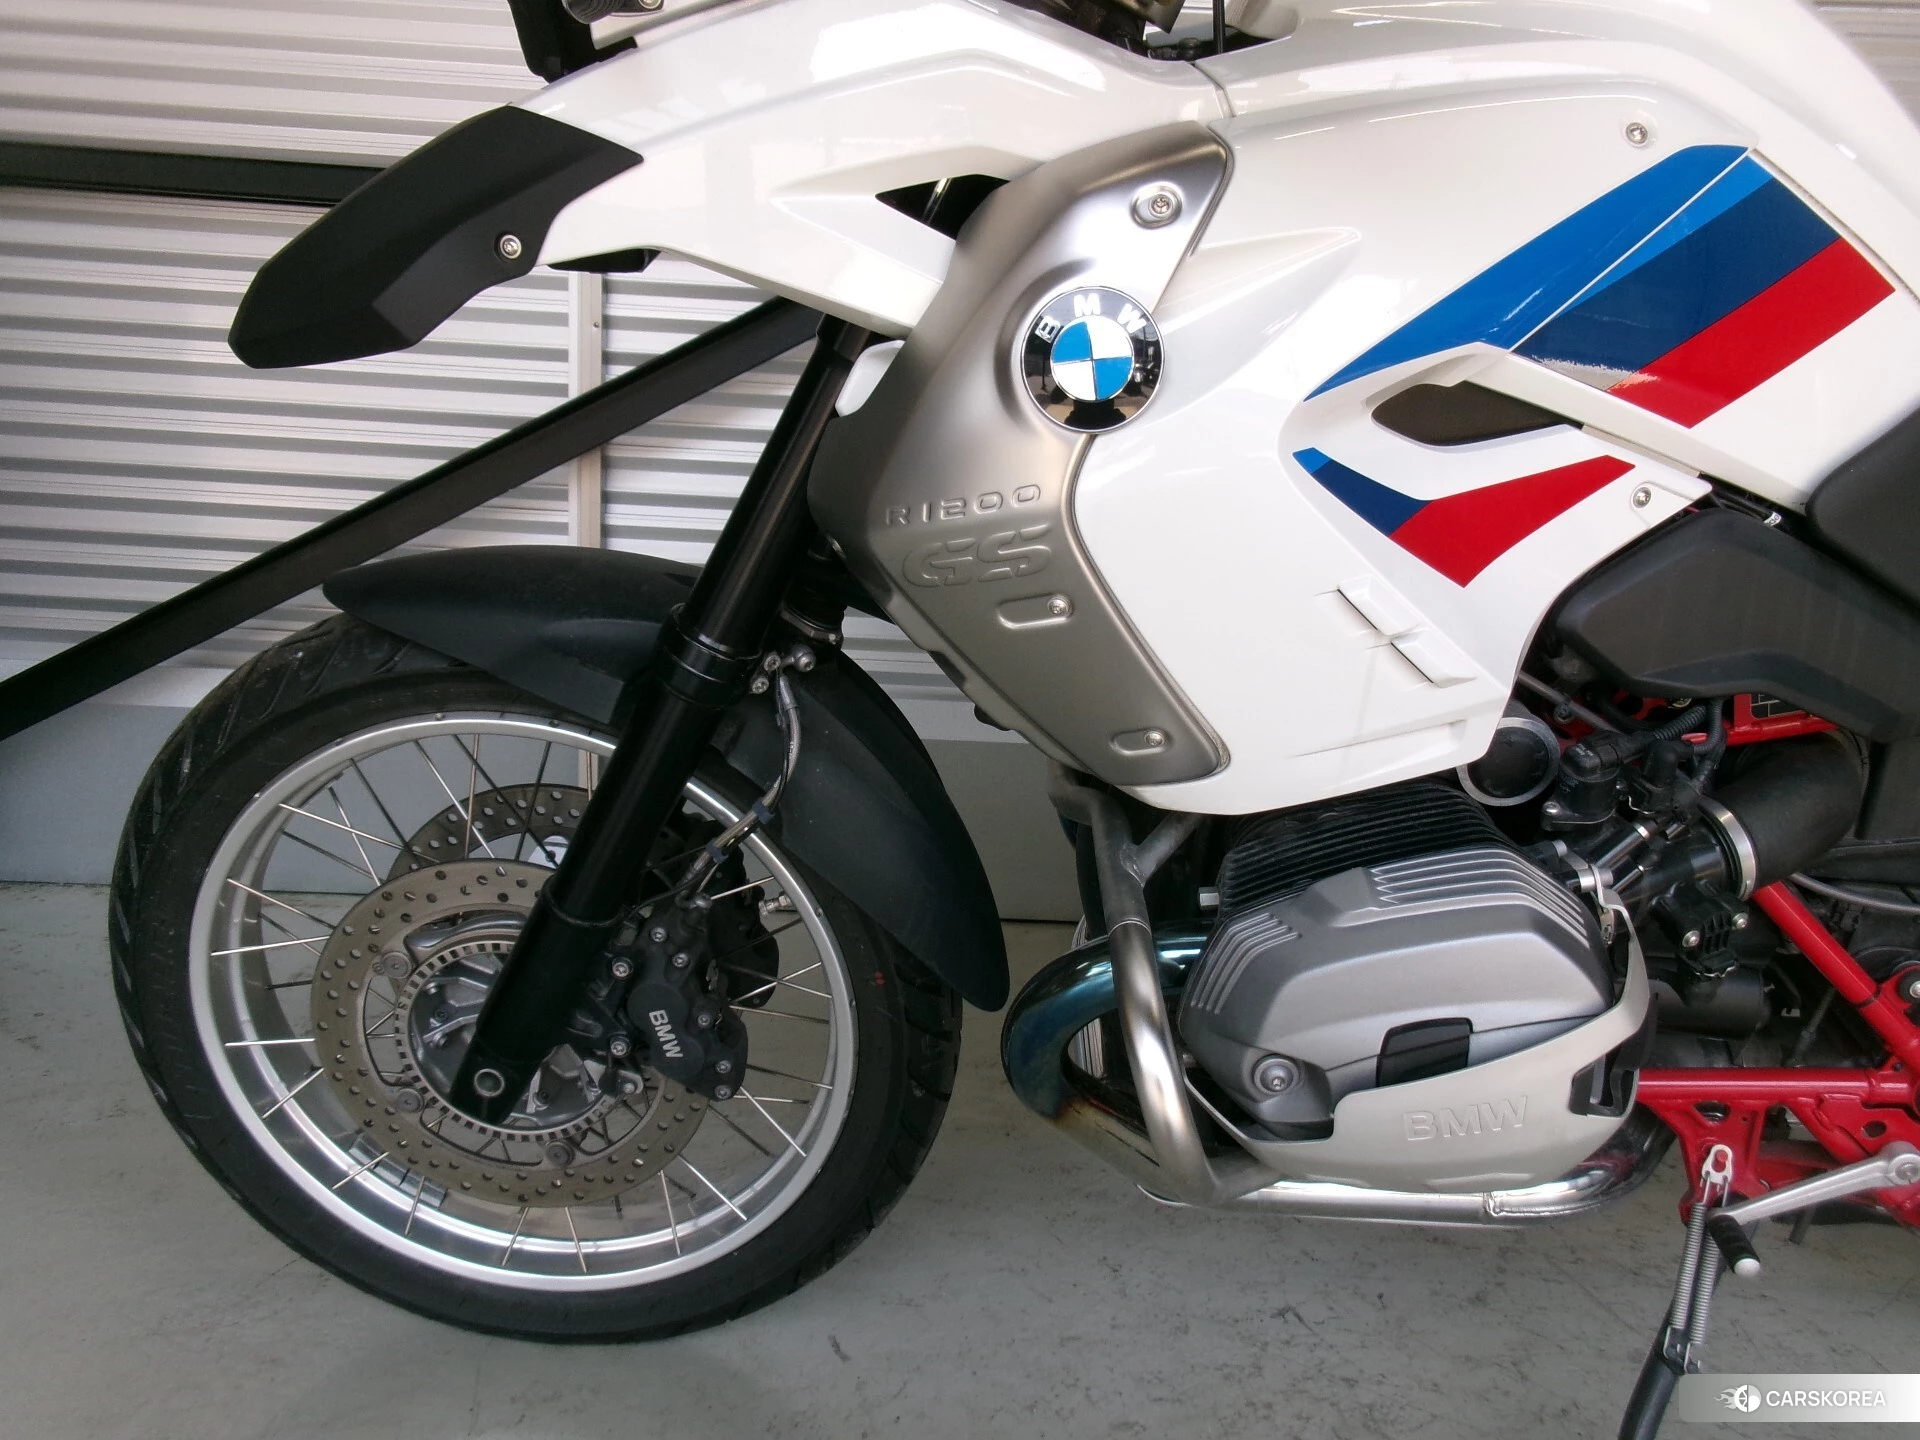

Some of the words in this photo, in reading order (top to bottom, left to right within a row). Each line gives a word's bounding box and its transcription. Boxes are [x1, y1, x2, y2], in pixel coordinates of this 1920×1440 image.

[1034, 293, 1147, 343] BMW
[903, 524, 1051, 587] GS
[649, 1009, 683, 1057] BMW
[1403, 1095, 1528, 1141] BMW
